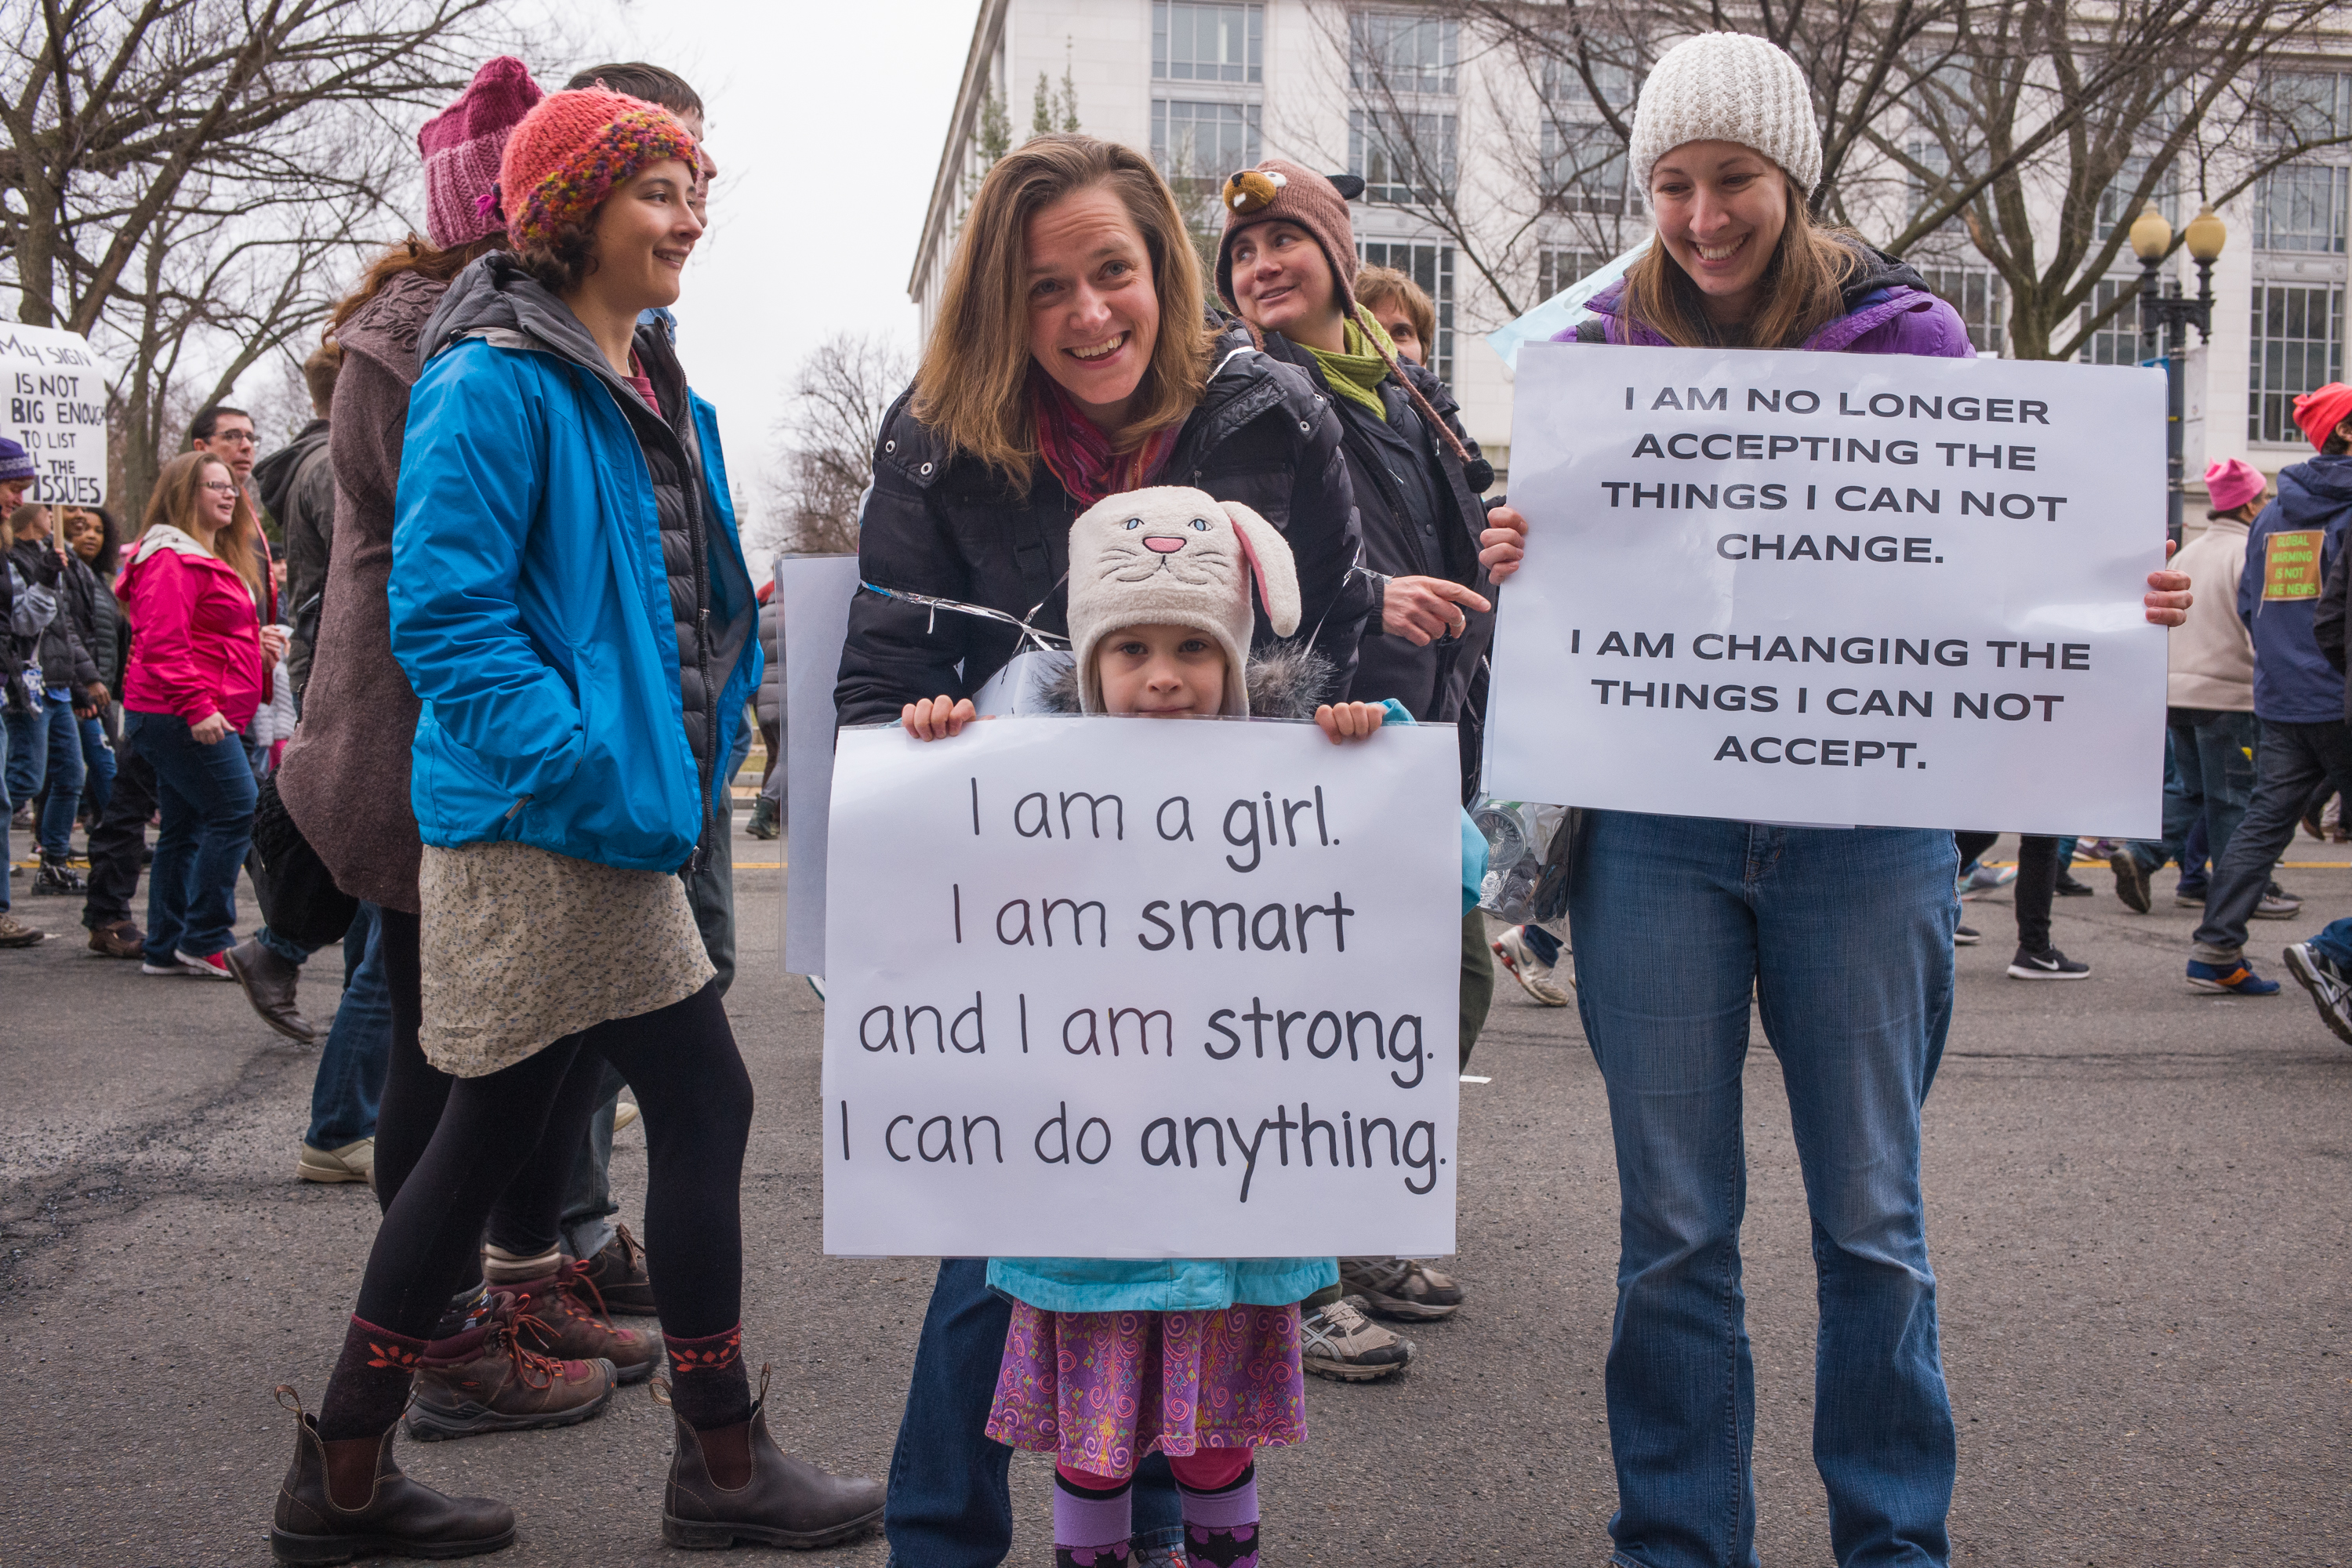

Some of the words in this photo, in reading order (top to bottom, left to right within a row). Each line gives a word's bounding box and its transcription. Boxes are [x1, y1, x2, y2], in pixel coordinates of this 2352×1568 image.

[46, 347, 92, 367] SIGN
[16, 372, 34, 394] IS
[40, 375, 78, 397] NOT
[12, 397, 44, 423] BIG
[1626, 387, 1633, 409] I
[1652, 387, 1727, 410] AM
[1748, 389, 1820, 413] NO
[1840, 393, 2049, 424] LONGER
[21, 430, 40, 448] TO
[48, 433, 76, 448] LIST
[1632, 434, 1918, 464] ACCEPTING
[1936, 443, 2035, 471] THE
[48, 460, 75, 474] THE
[33, 474, 101, 503] ISSUES
[1602, 482, 1787, 510] THINGS
[1807, 485, 1816, 510] I
[1835, 486, 1940, 514] CAN
[1962, 491, 2067, 521] NOT
[1717, 534, 1943, 563] CHANGE.
[2277, 535, 2310, 547] GLOBAL
[2272, 550, 2313, 563] WARMING
[2285, 567, 2304, 579] NOT
[2287, 583, 2316, 595] NEWS
[1572, 630, 1580, 653] I
[1596, 631, 1674, 658] AM
[1693, 633, 1968, 666] CHANGING
[1987, 641, 2090, 670] THE
[1592, 680, 1778, 712] THINGS
[1798, 688, 1806, 713] I
[1827, 688, 1933, 717] CAN
[1954, 692, 2064, 721] NOT
[1714, 736, 1926, 769] ACCEPT.
[971, 778, 979, 835] I
[1014, 792, 1123, 840] am
[1157, 797, 1193, 841] a
[1223, 786, 1339, 873] girl.
[953, 884, 961, 943] I
[996, 898, 1105, 947] am
[1138, 891, 1354, 953] smart
[860, 991, 985, 1054] and
[1019, 994, 1028, 1053] I
[1063, 1007, 1172, 1057] am
[1204, 996, 1433, 1089] strong.
[841, 1100, 850, 1160] I
[886, 1115, 1003, 1165] can
[1035, 1101, 1111, 1164] do
[1141, 1102, 1446, 1203] anything.
